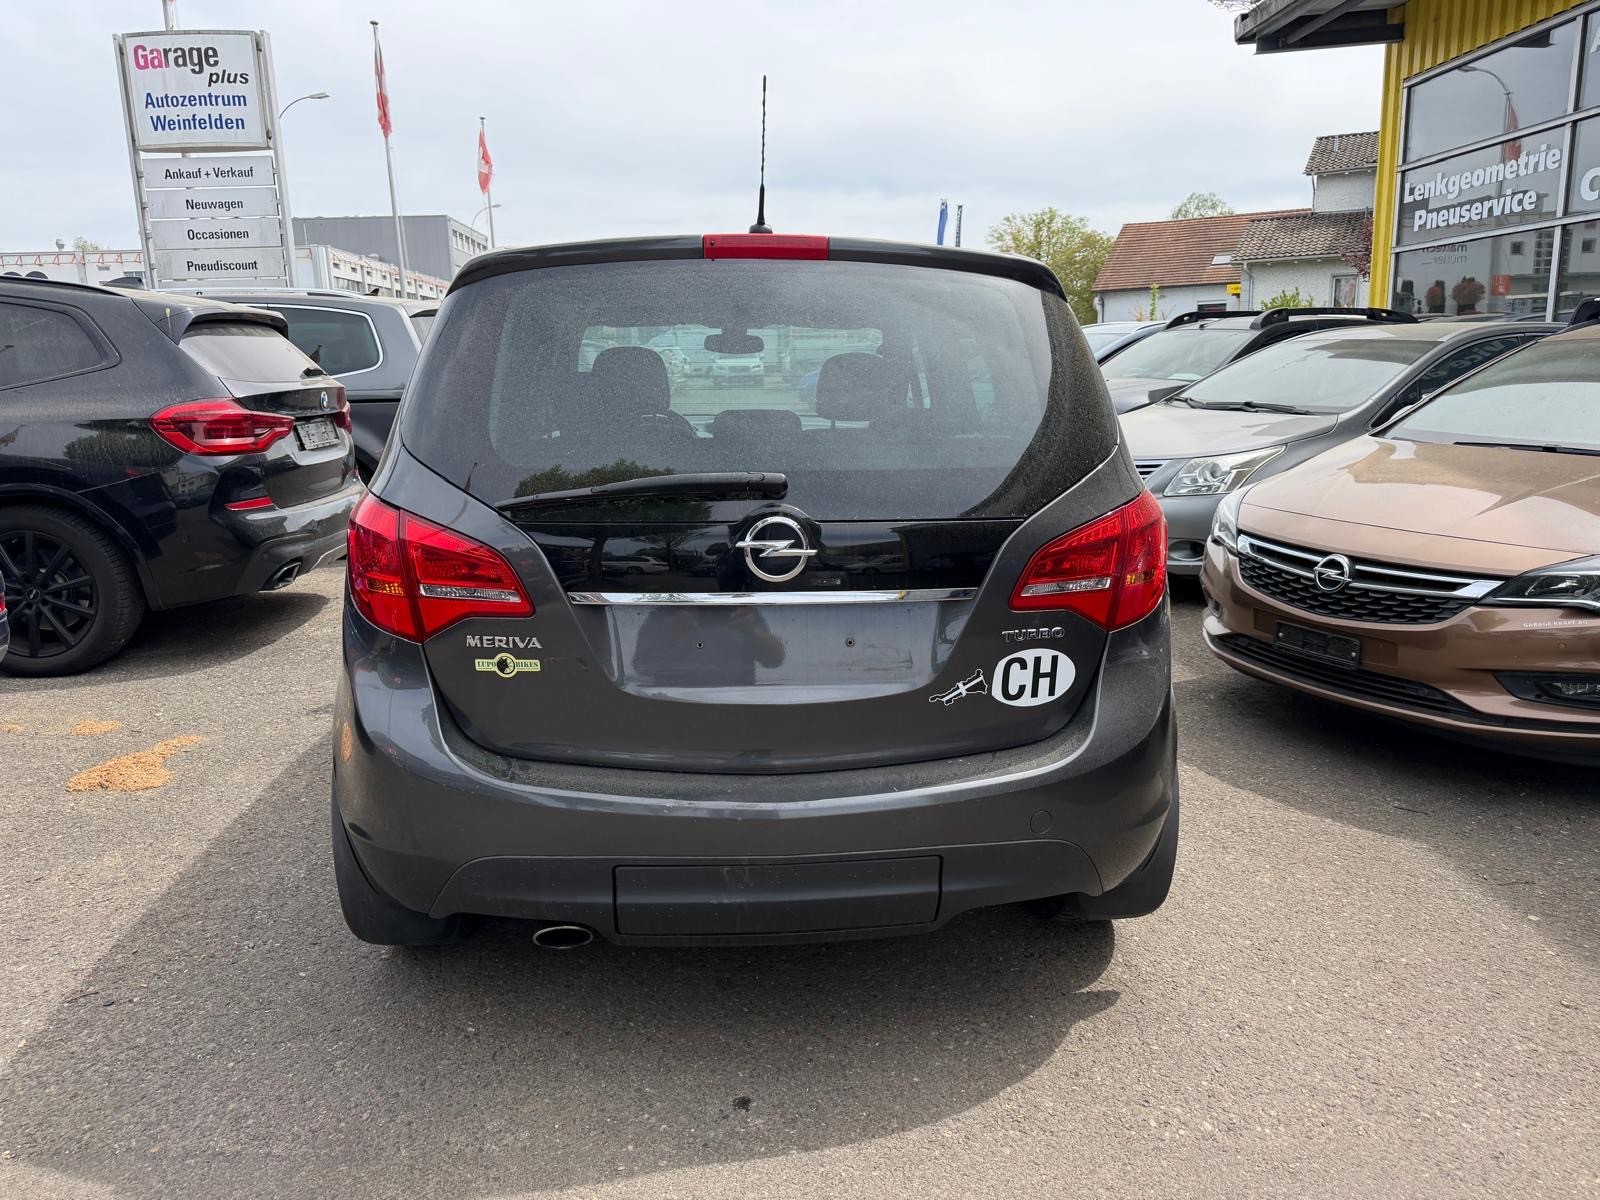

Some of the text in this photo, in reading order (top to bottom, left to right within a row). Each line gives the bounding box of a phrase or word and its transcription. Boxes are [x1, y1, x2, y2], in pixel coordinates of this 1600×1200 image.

[133, 44, 219, 74] Garage
[207, 69, 249, 87] plus
[145, 92, 247, 109] Autozentrum
[150, 113, 246, 132] Weinfelden
[164, 168, 202, 180] Ankauf
[212, 166, 254, 179] Verkauf
[1403, 143, 1562, 204] Lenkgeometrie
[185, 199, 244, 212] Neuwagen
[1413, 188, 1537, 232] Pneuservice
[187, 228, 250, 241] Occasionen
[186, 260, 258, 272] Pneudiscount
[466, 635, 543, 649] MERIVA
[1001, 626, 1065, 642] TURBO
[477, 660, 497, 668] LUPO
[1001, 654, 1059, 701] CH
